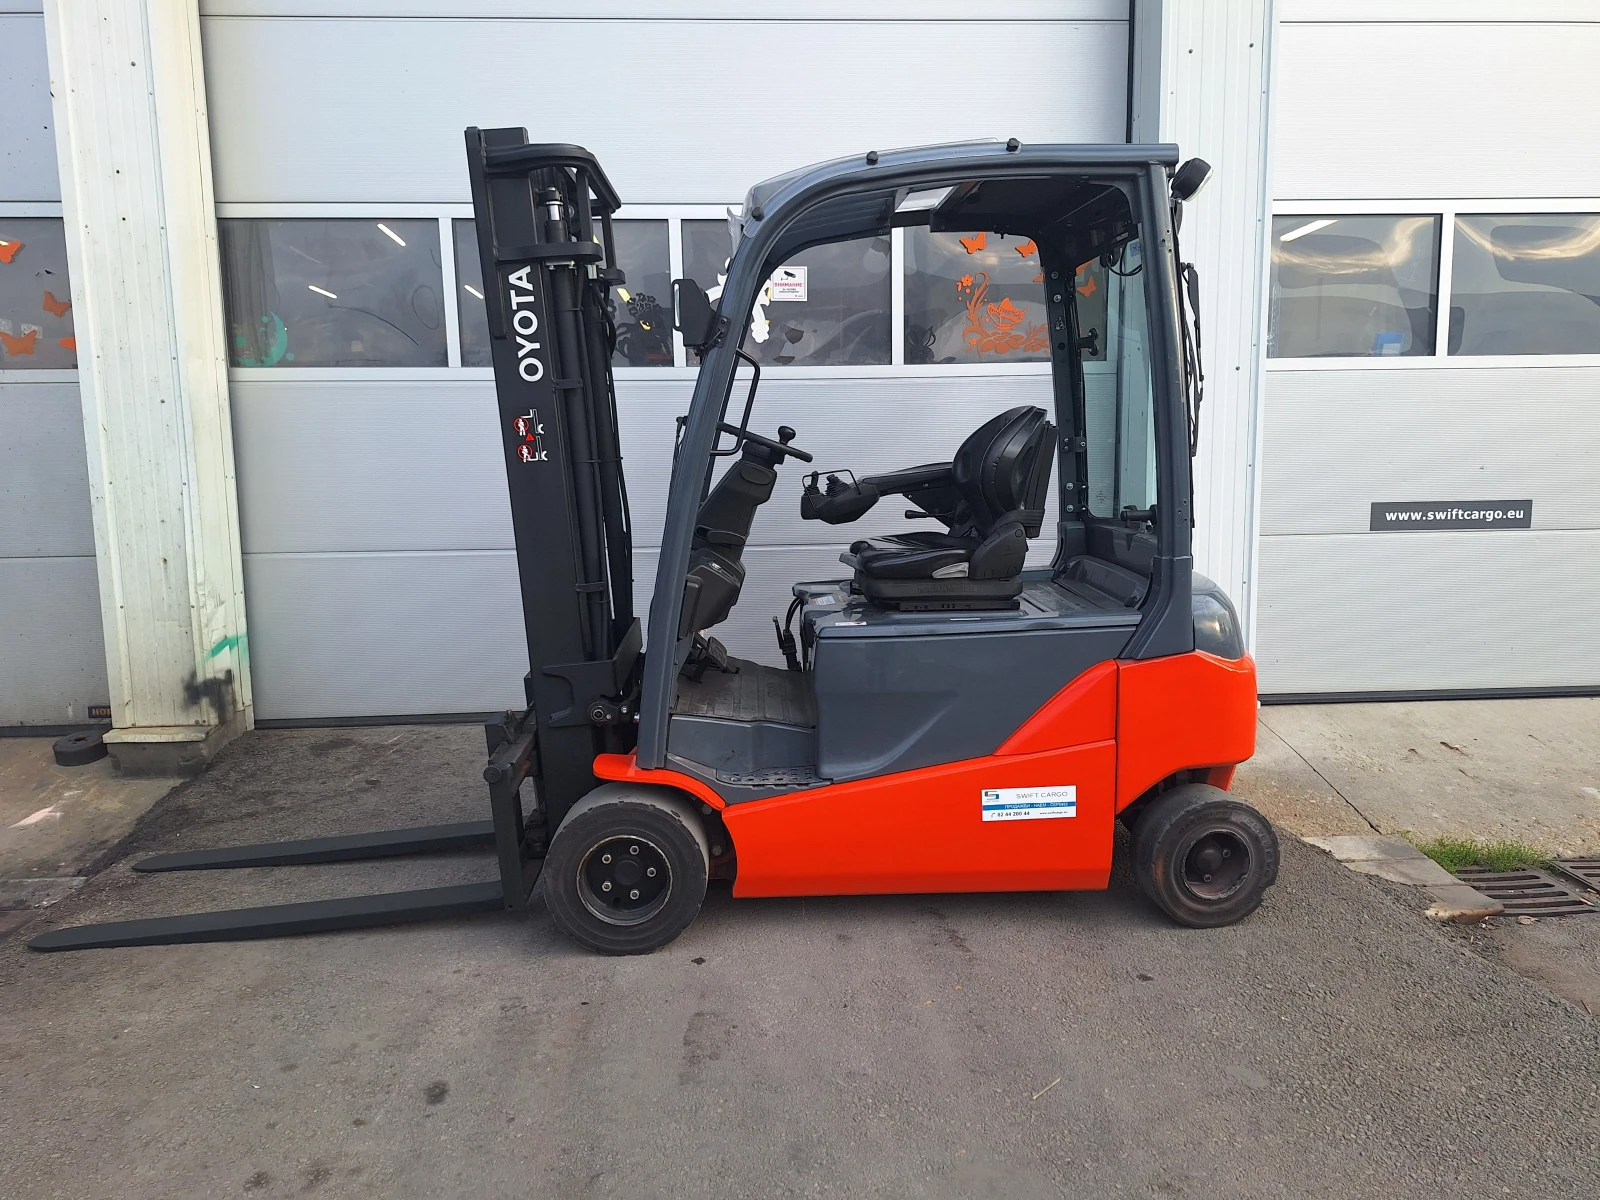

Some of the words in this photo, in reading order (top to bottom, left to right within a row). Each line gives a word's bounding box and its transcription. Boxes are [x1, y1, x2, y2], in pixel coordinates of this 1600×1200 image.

[508, 265, 544, 382] OYOTA
[1385, 508, 1524, 522] www.swiftcargo.eu
[1016, 792, 1039, 800] SWIFT
